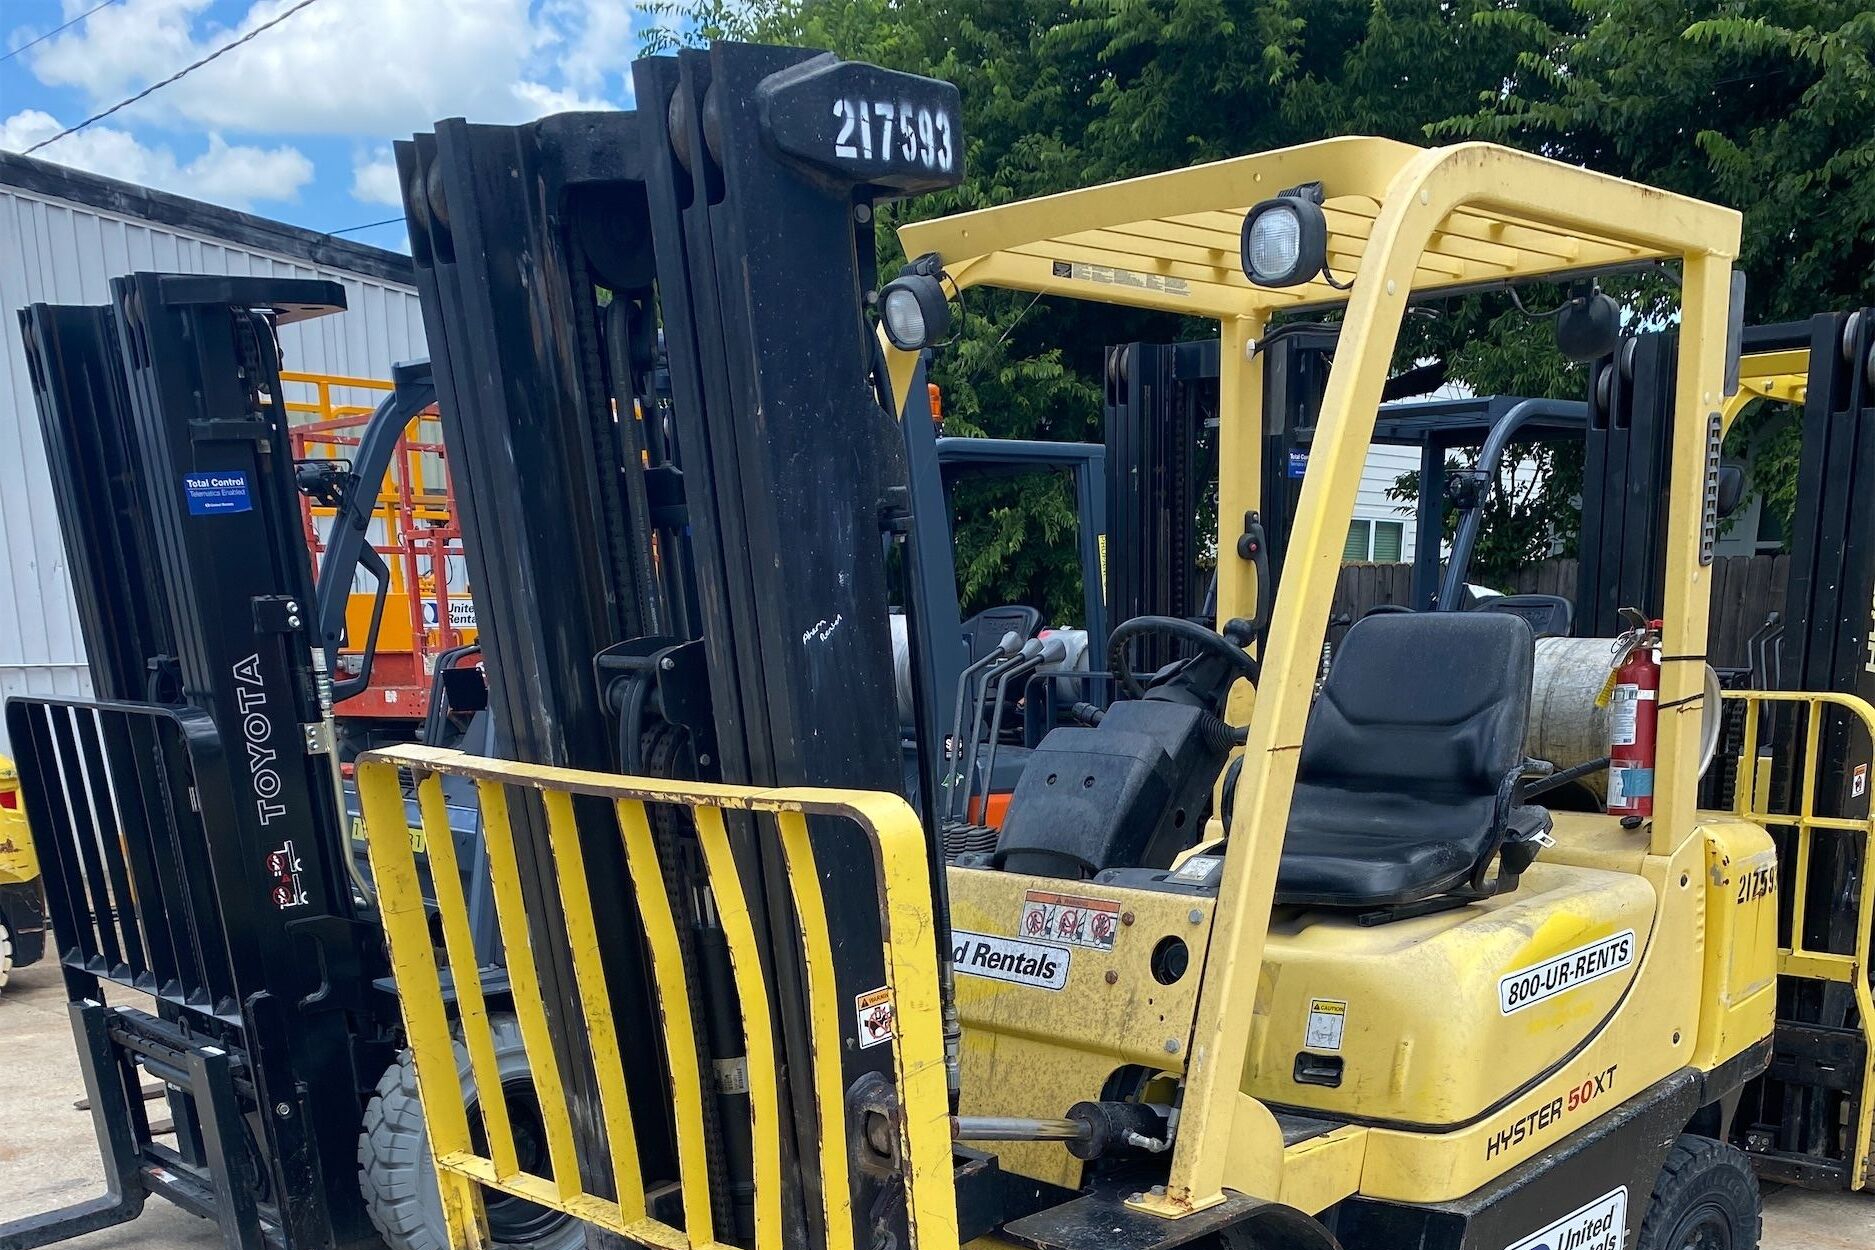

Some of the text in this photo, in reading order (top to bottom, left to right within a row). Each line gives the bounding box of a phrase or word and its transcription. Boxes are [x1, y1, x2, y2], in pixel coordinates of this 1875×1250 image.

[833, 99, 952, 170] 217593
[186, 477, 244, 488] Total Control
[233, 653, 287, 826] TOYOTA
[971, 942, 1056, 979] Rentals
[1508, 940, 1629, 1006] 800-UR-RENTS
[1487, 1097, 1563, 1161] HYSTER
